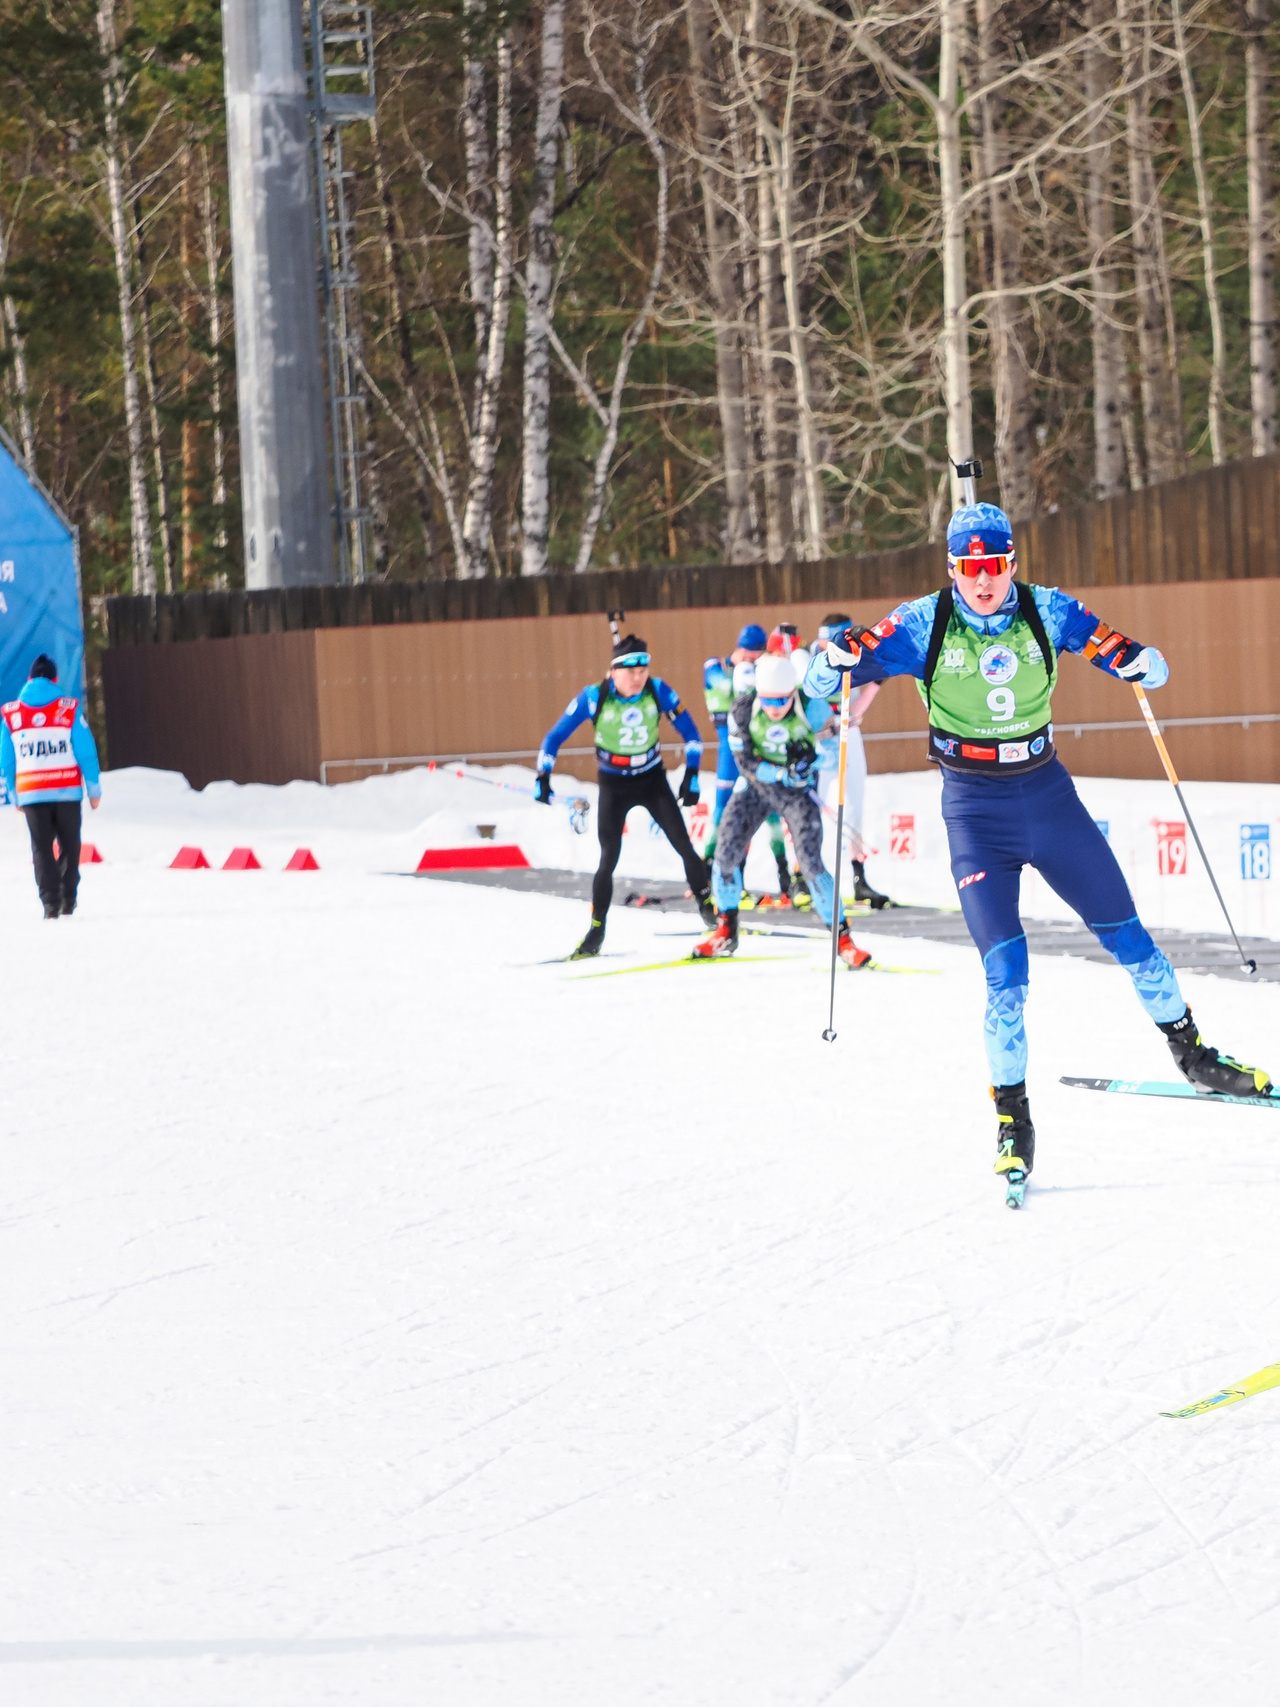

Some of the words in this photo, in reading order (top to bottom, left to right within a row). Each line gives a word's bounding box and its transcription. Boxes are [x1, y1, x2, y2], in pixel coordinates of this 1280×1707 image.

[986, 686, 1016, 722] 9
[20, 740, 67, 758] СУДЬЯ
[618, 725, 649, 746] 23
[1158, 838, 1186, 874] 19
[1241, 842, 1270, 879] 18
